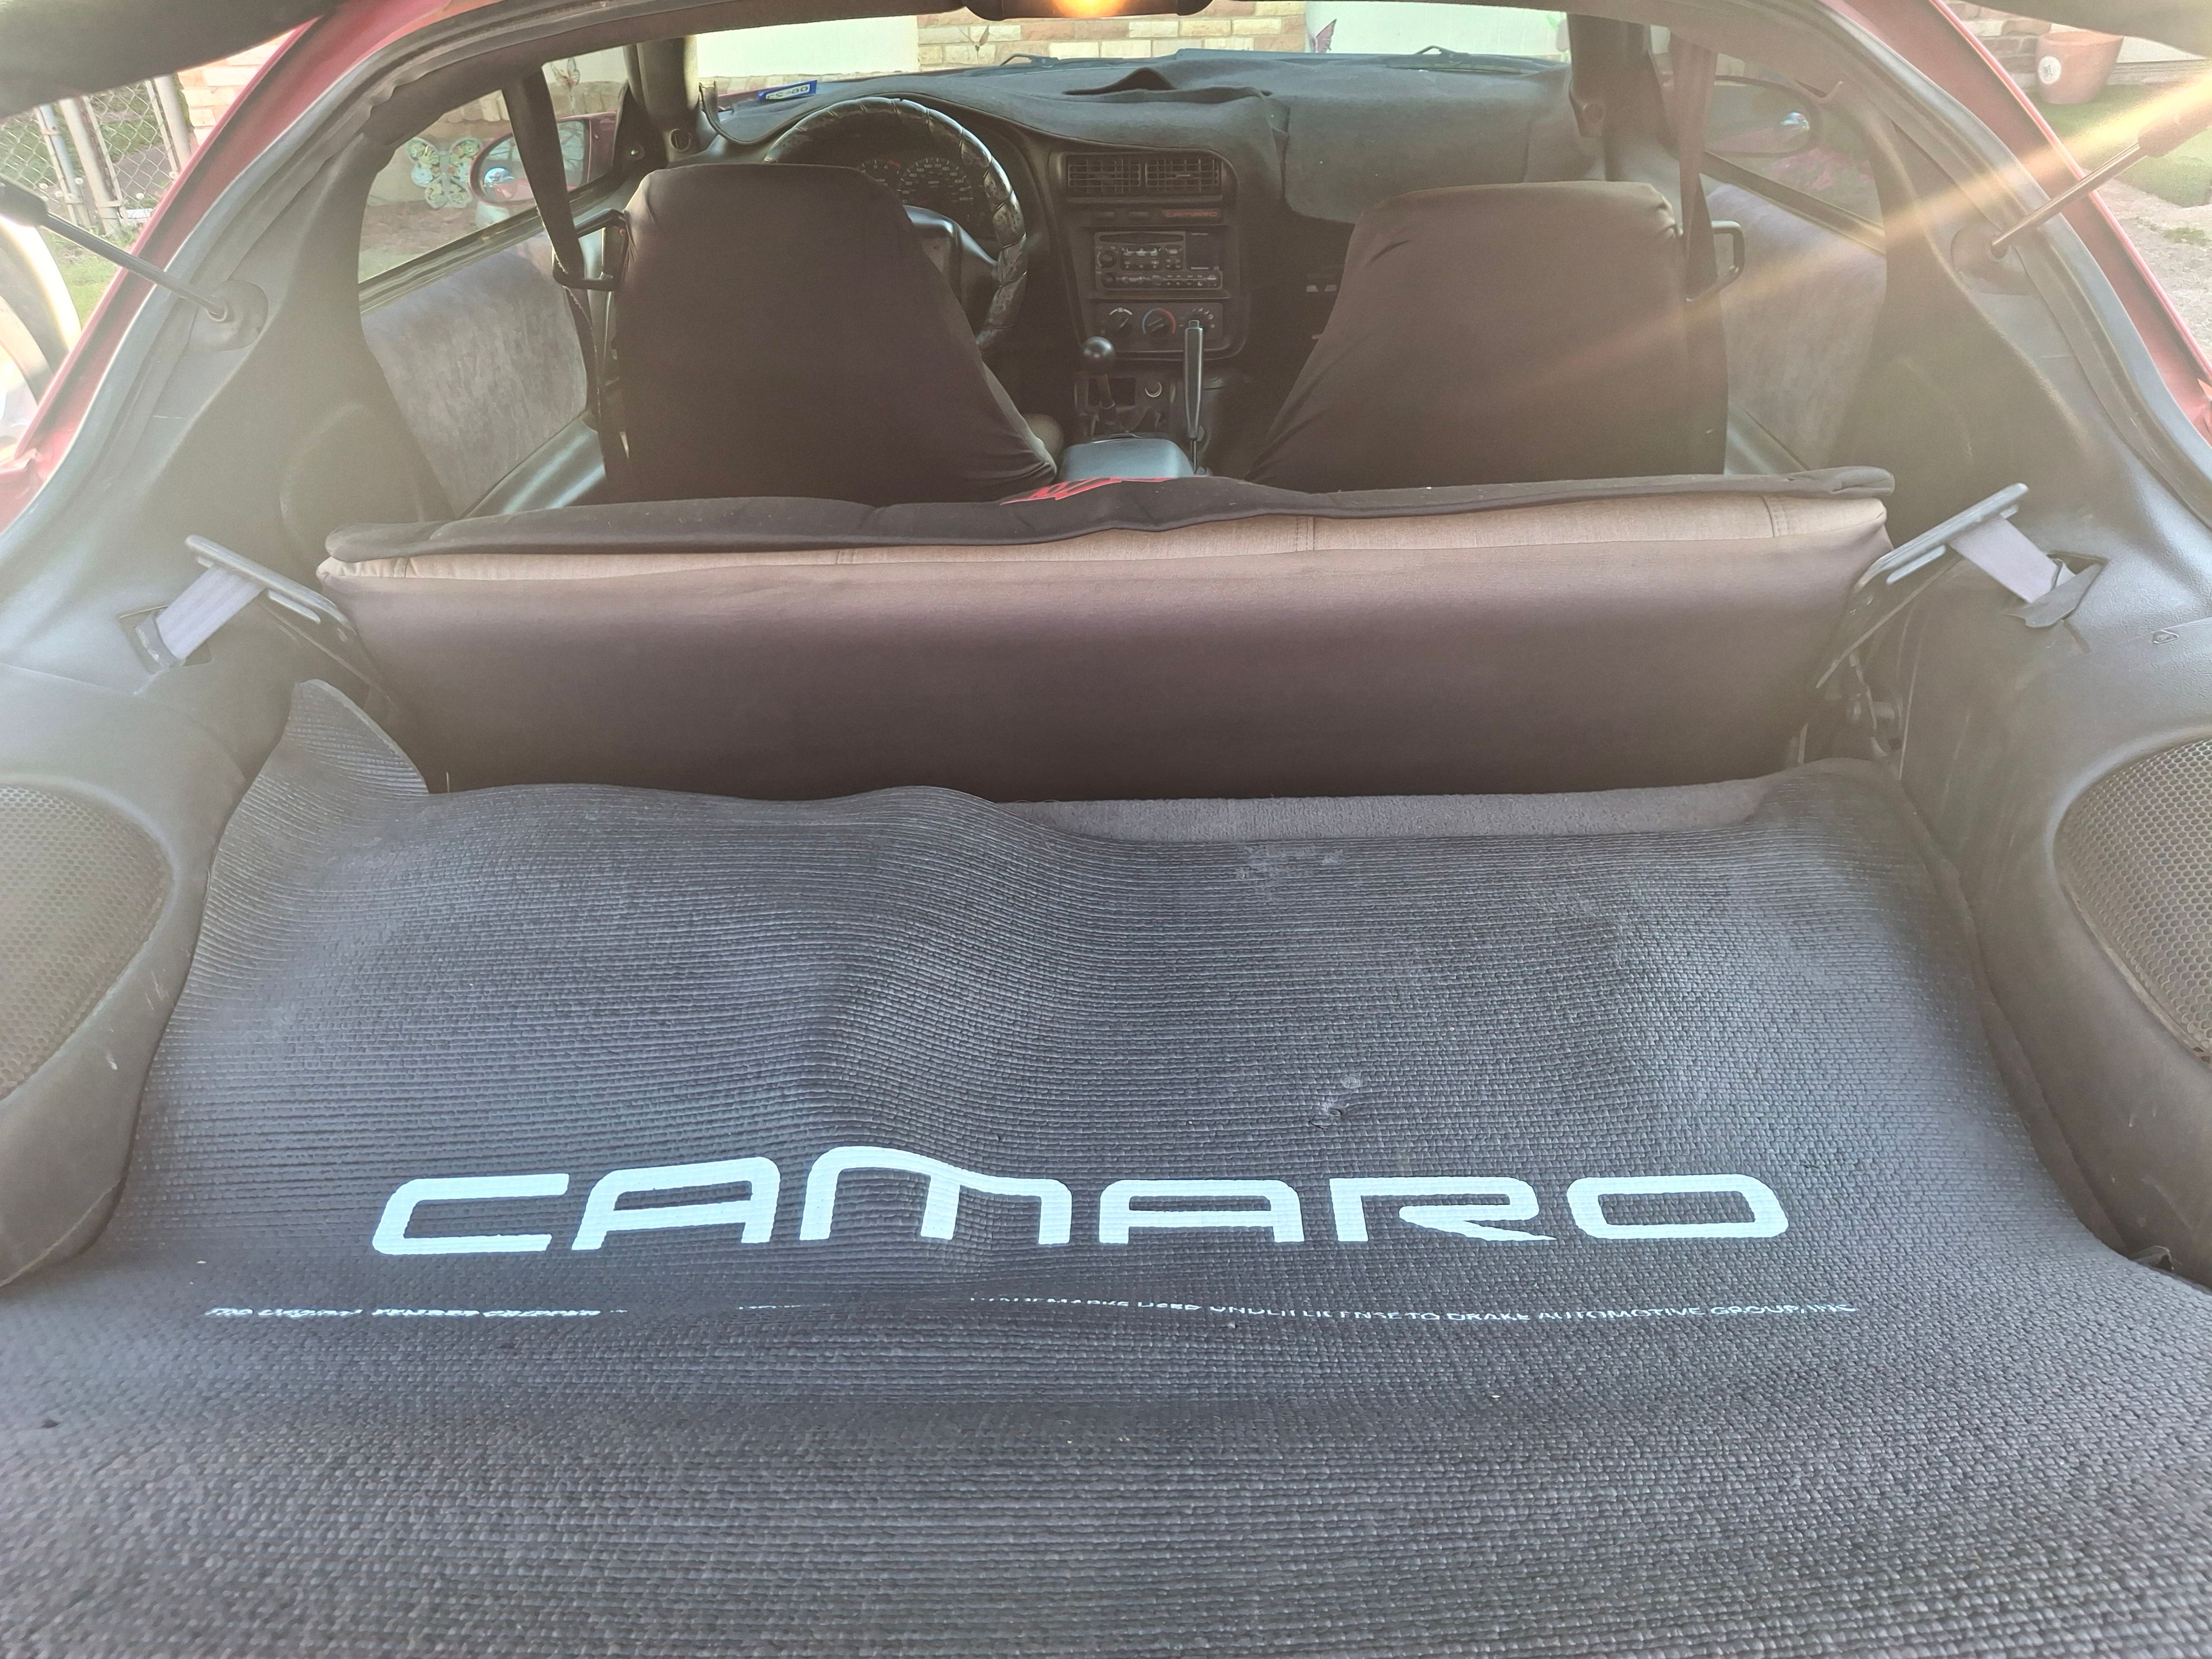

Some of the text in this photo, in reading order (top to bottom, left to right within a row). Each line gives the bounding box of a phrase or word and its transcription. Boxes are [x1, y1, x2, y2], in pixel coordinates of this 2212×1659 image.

[371, 1145, 1790, 1256] CAMARO
[1405, 1312, 1440, 1320] TO
[1447, 1312, 1531, 1321] DRAKE
[1538, 1307, 1706, 1320] AUTOMOTIVE
